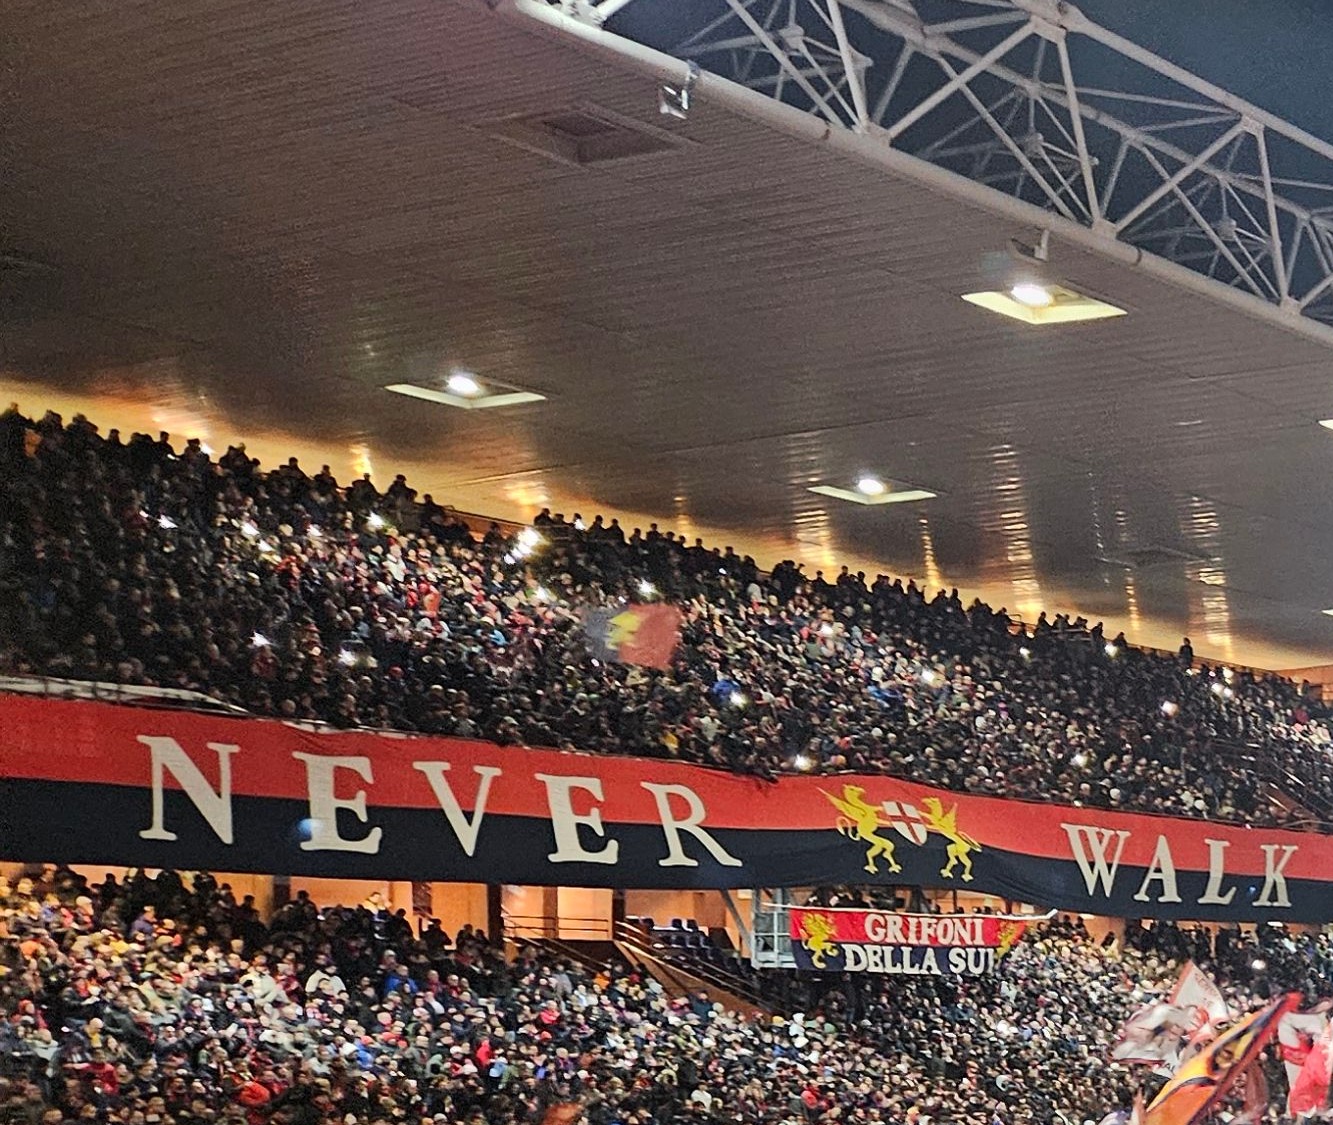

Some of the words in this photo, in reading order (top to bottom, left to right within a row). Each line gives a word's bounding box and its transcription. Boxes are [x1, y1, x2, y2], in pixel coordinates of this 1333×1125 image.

[137, 734, 743, 868] NEVER
[1060, 822, 1299, 908] WALK
[863, 913, 985, 946] GRIFONI
[841, 943, 943, 975] DELLA
